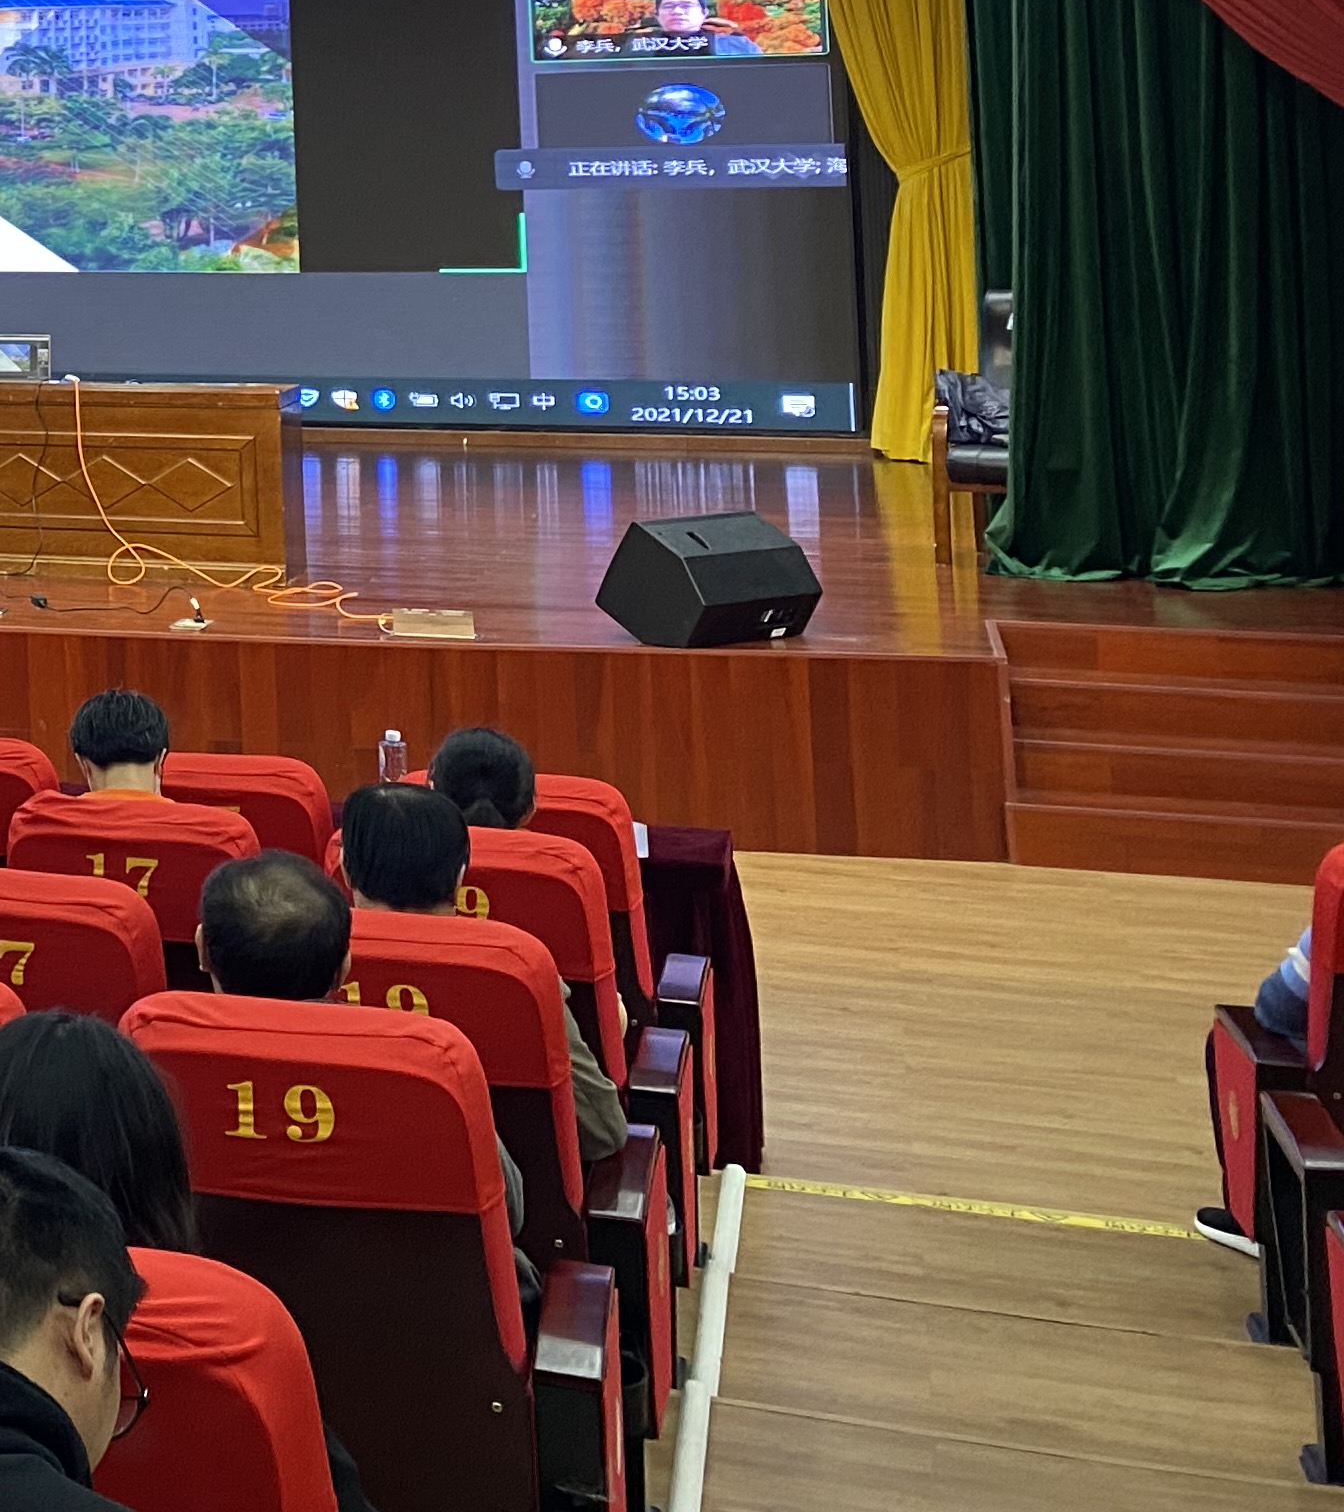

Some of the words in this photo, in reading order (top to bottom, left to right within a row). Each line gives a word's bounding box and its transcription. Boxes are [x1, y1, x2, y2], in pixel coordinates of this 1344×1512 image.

[532, 390, 556, 411] 中
[663, 385, 722, 403] 15:03
[630, 405, 755, 425] 2021/12/21
[84, 852, 160, 898] 17
[454, 885, 490, 921] 9
[224, 1080, 336, 1143] 19
